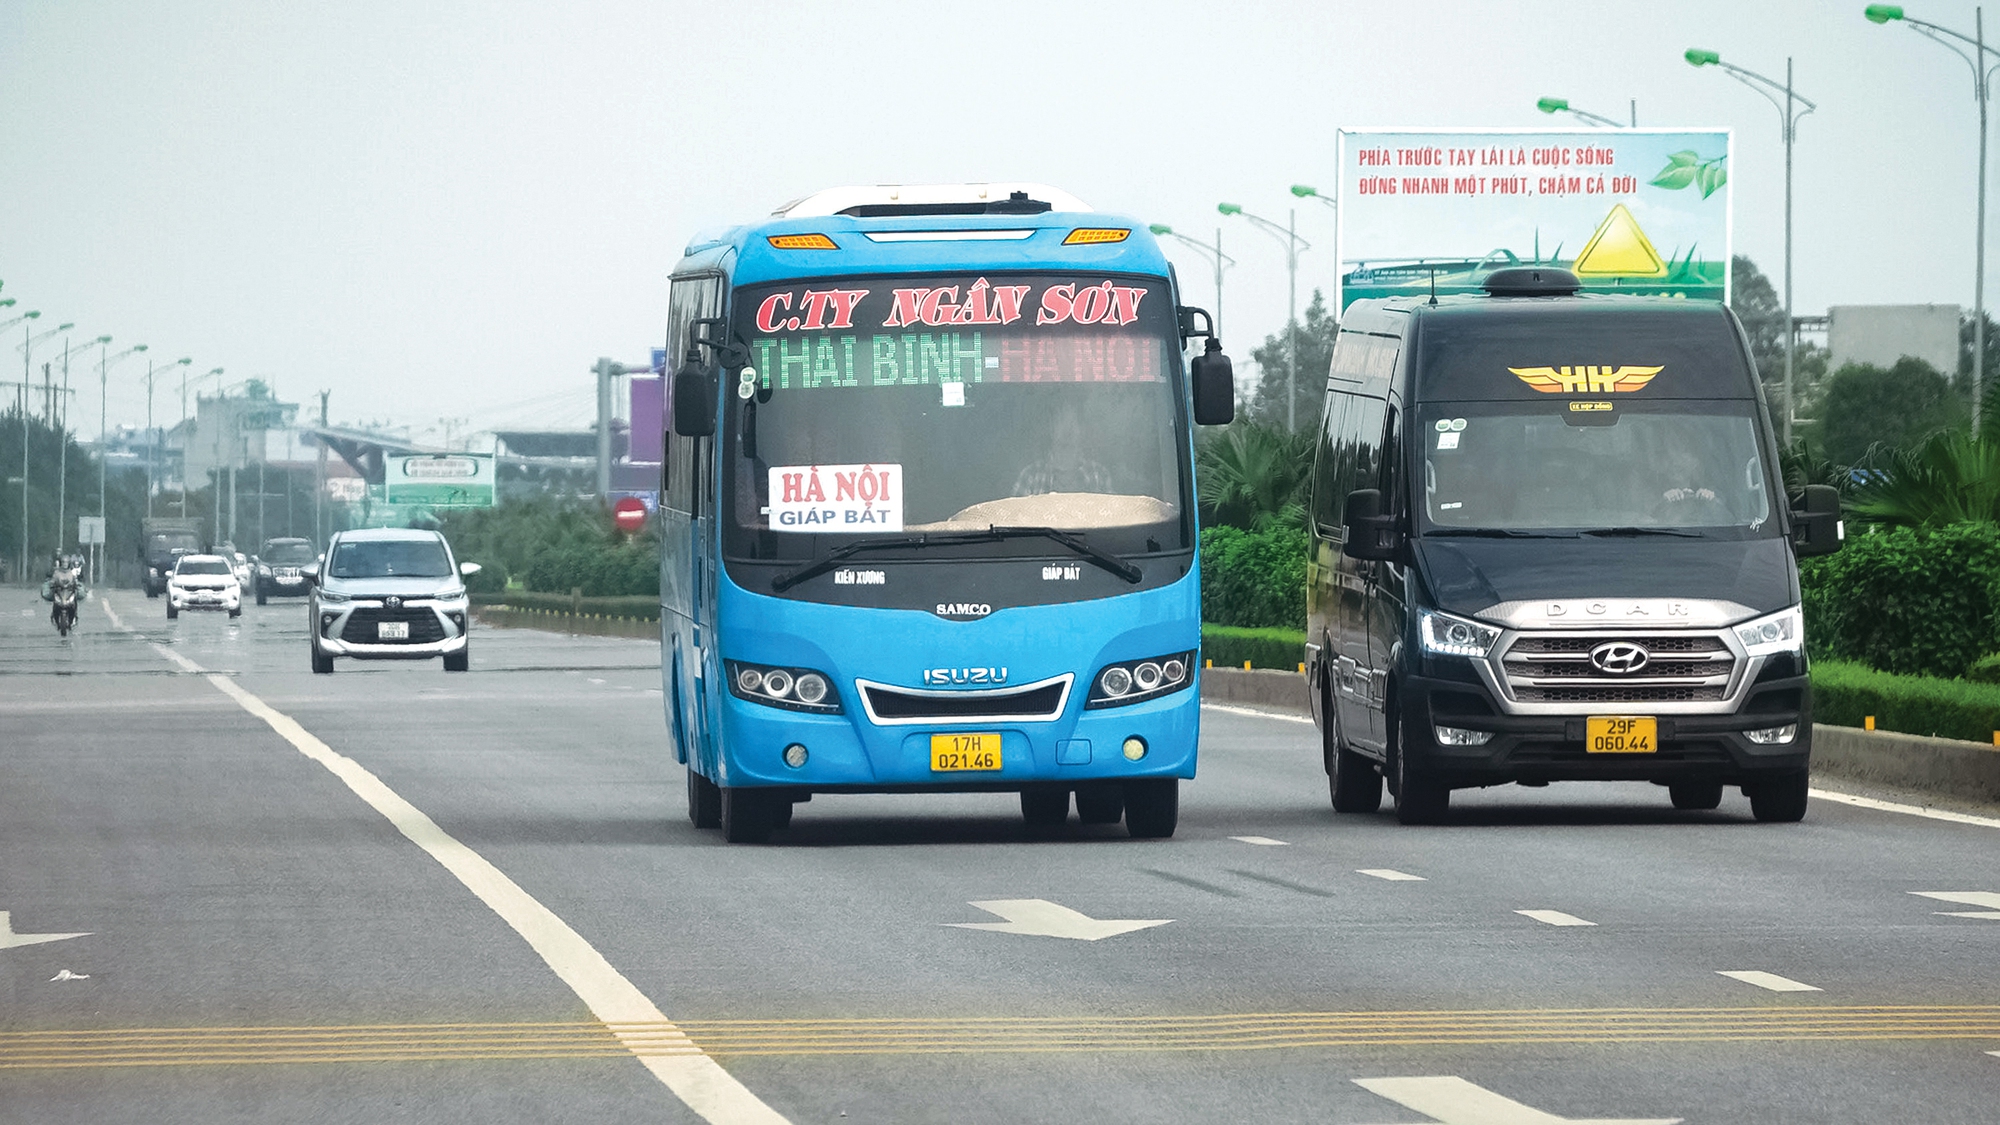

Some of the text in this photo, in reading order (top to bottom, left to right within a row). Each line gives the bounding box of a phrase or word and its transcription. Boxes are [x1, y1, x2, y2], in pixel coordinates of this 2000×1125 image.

[1397, 147, 1442, 166] TRƯỚC
[1448, 149, 1476, 166] TAY
[1481, 145, 1504, 166] LÁI
[1509, 145, 1526, 166] LÀ
[1532, 145, 1570, 169] CUỘC
[1576, 143, 1614, 166] SỐNG
[1359, 175, 1397, 194] ĐỪNG
[1402, 177, 1449, 194] NHANH
[1454, 174, 1486, 198] MỘT
[1491, 174, 1532, 197] PHÚT,
[1538, 174, 1581, 198] CHẬM
[1612, 174, 1637, 194] ĐỜI
[756, 276, 1148, 333] C.TY NGÂN SƠN
[782, 464, 890, 507] HÀ NỘI
[779, 506, 891, 526] GIÁP BÁT
[1042, 563, 1081, 581] GIÁP BÁT
[936, 603, 991, 616] SAMCO
[1546, 601, 1690, 617] DCAR
[923, 666, 1008, 685] ISUZU
[1607, 719, 1637, 735] 29F
[952, 736, 981, 752] 17H
[1594, 735, 1649, 751] 060.44
[938, 752, 994, 769] 021.46
